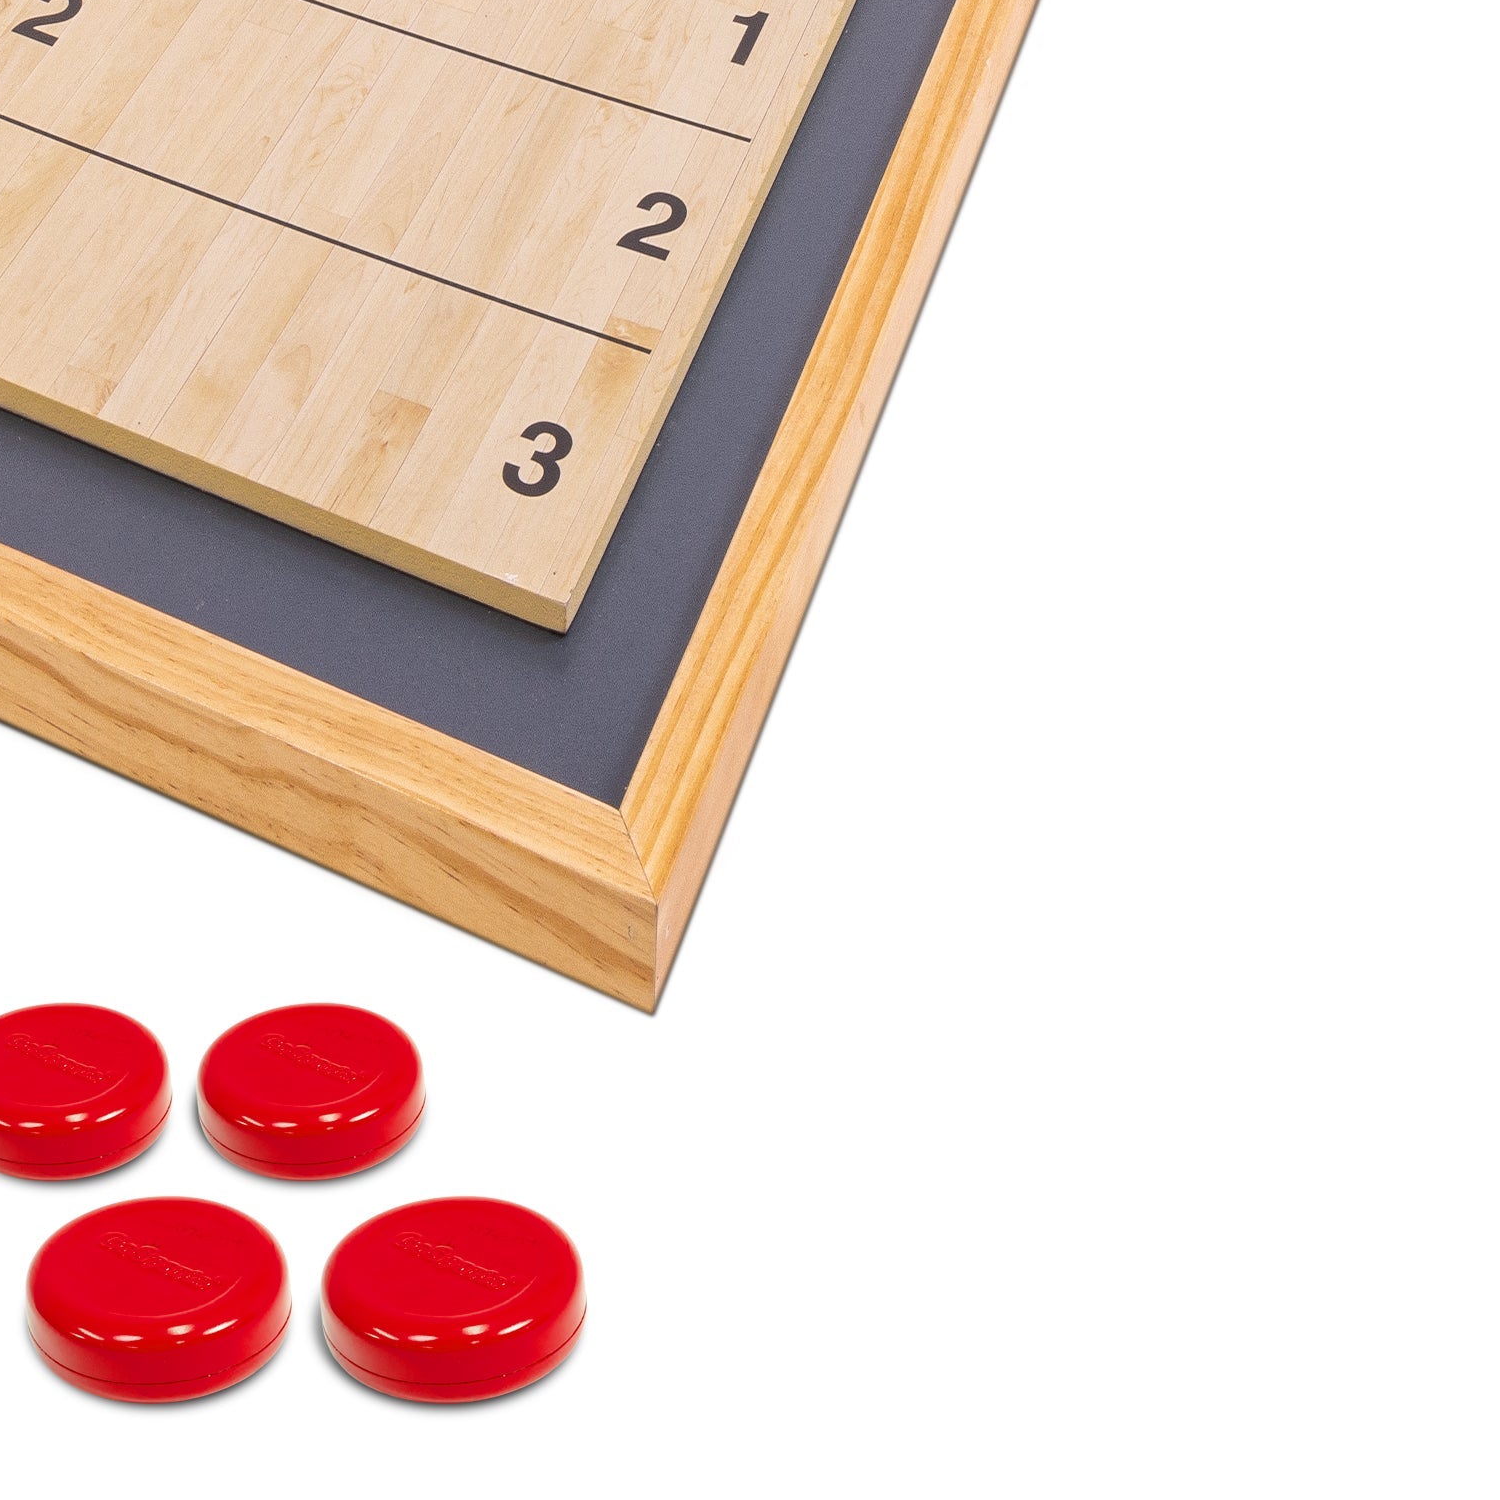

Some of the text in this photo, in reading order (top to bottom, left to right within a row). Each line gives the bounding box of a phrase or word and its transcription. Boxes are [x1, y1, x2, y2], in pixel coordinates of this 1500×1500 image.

[730, 10, 770, 66] 1
[615, 191, 688, 262] 2
[502, 421, 573, 498] 3
